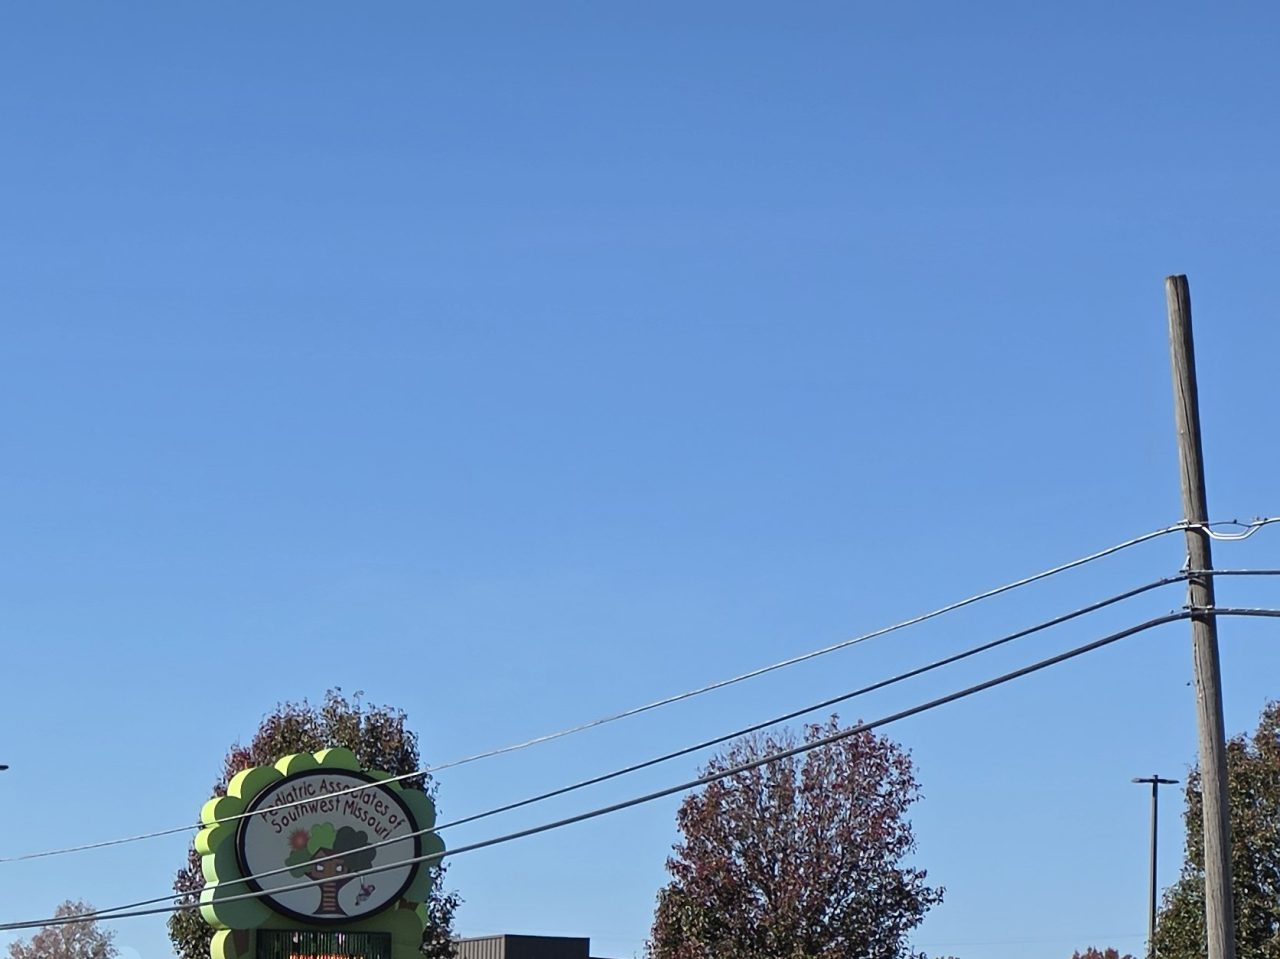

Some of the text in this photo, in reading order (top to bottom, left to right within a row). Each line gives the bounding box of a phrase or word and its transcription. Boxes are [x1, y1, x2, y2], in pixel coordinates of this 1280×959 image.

[260, 778, 406, 830] Pediatric Associates of
[271, 797, 393, 840] Southwest Missouri
